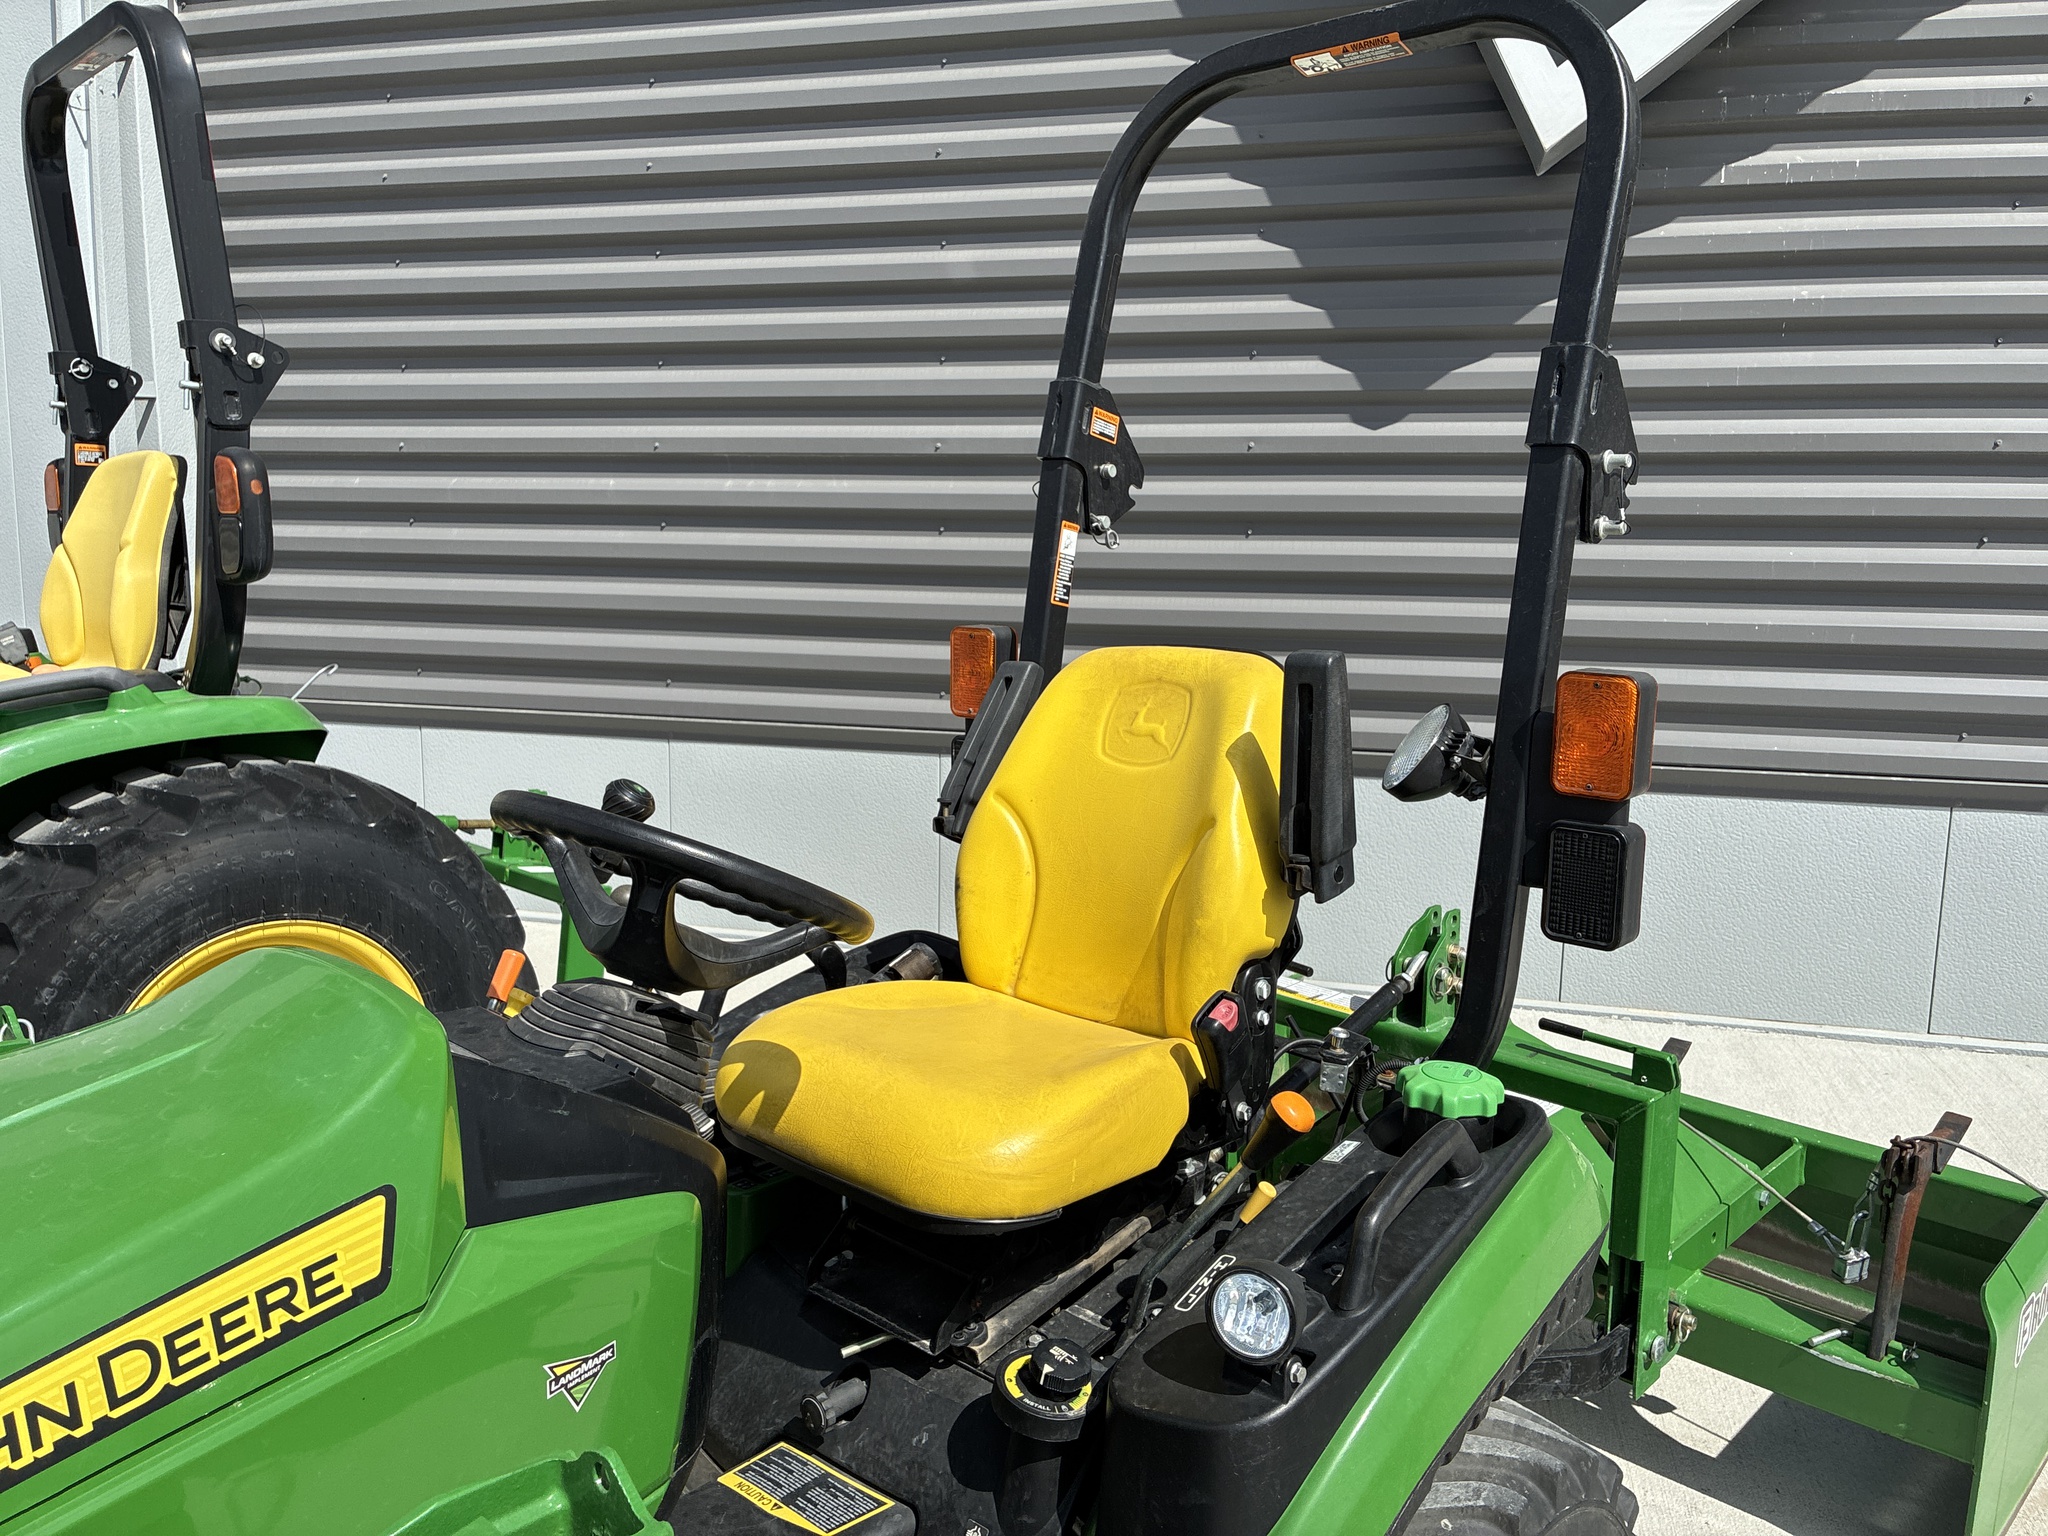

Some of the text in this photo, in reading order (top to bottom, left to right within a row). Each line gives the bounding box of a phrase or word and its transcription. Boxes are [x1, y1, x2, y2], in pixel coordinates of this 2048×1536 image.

[1350, 36, 1390, 51] WARNING
[97, 1252, 344, 1412] DEERE
[567, 1365, 601, 1388] IMPLEMENT
[1023, 1398, 1051, 1411] INSTALL
[734, 1481, 772, 1505] CAUTION
